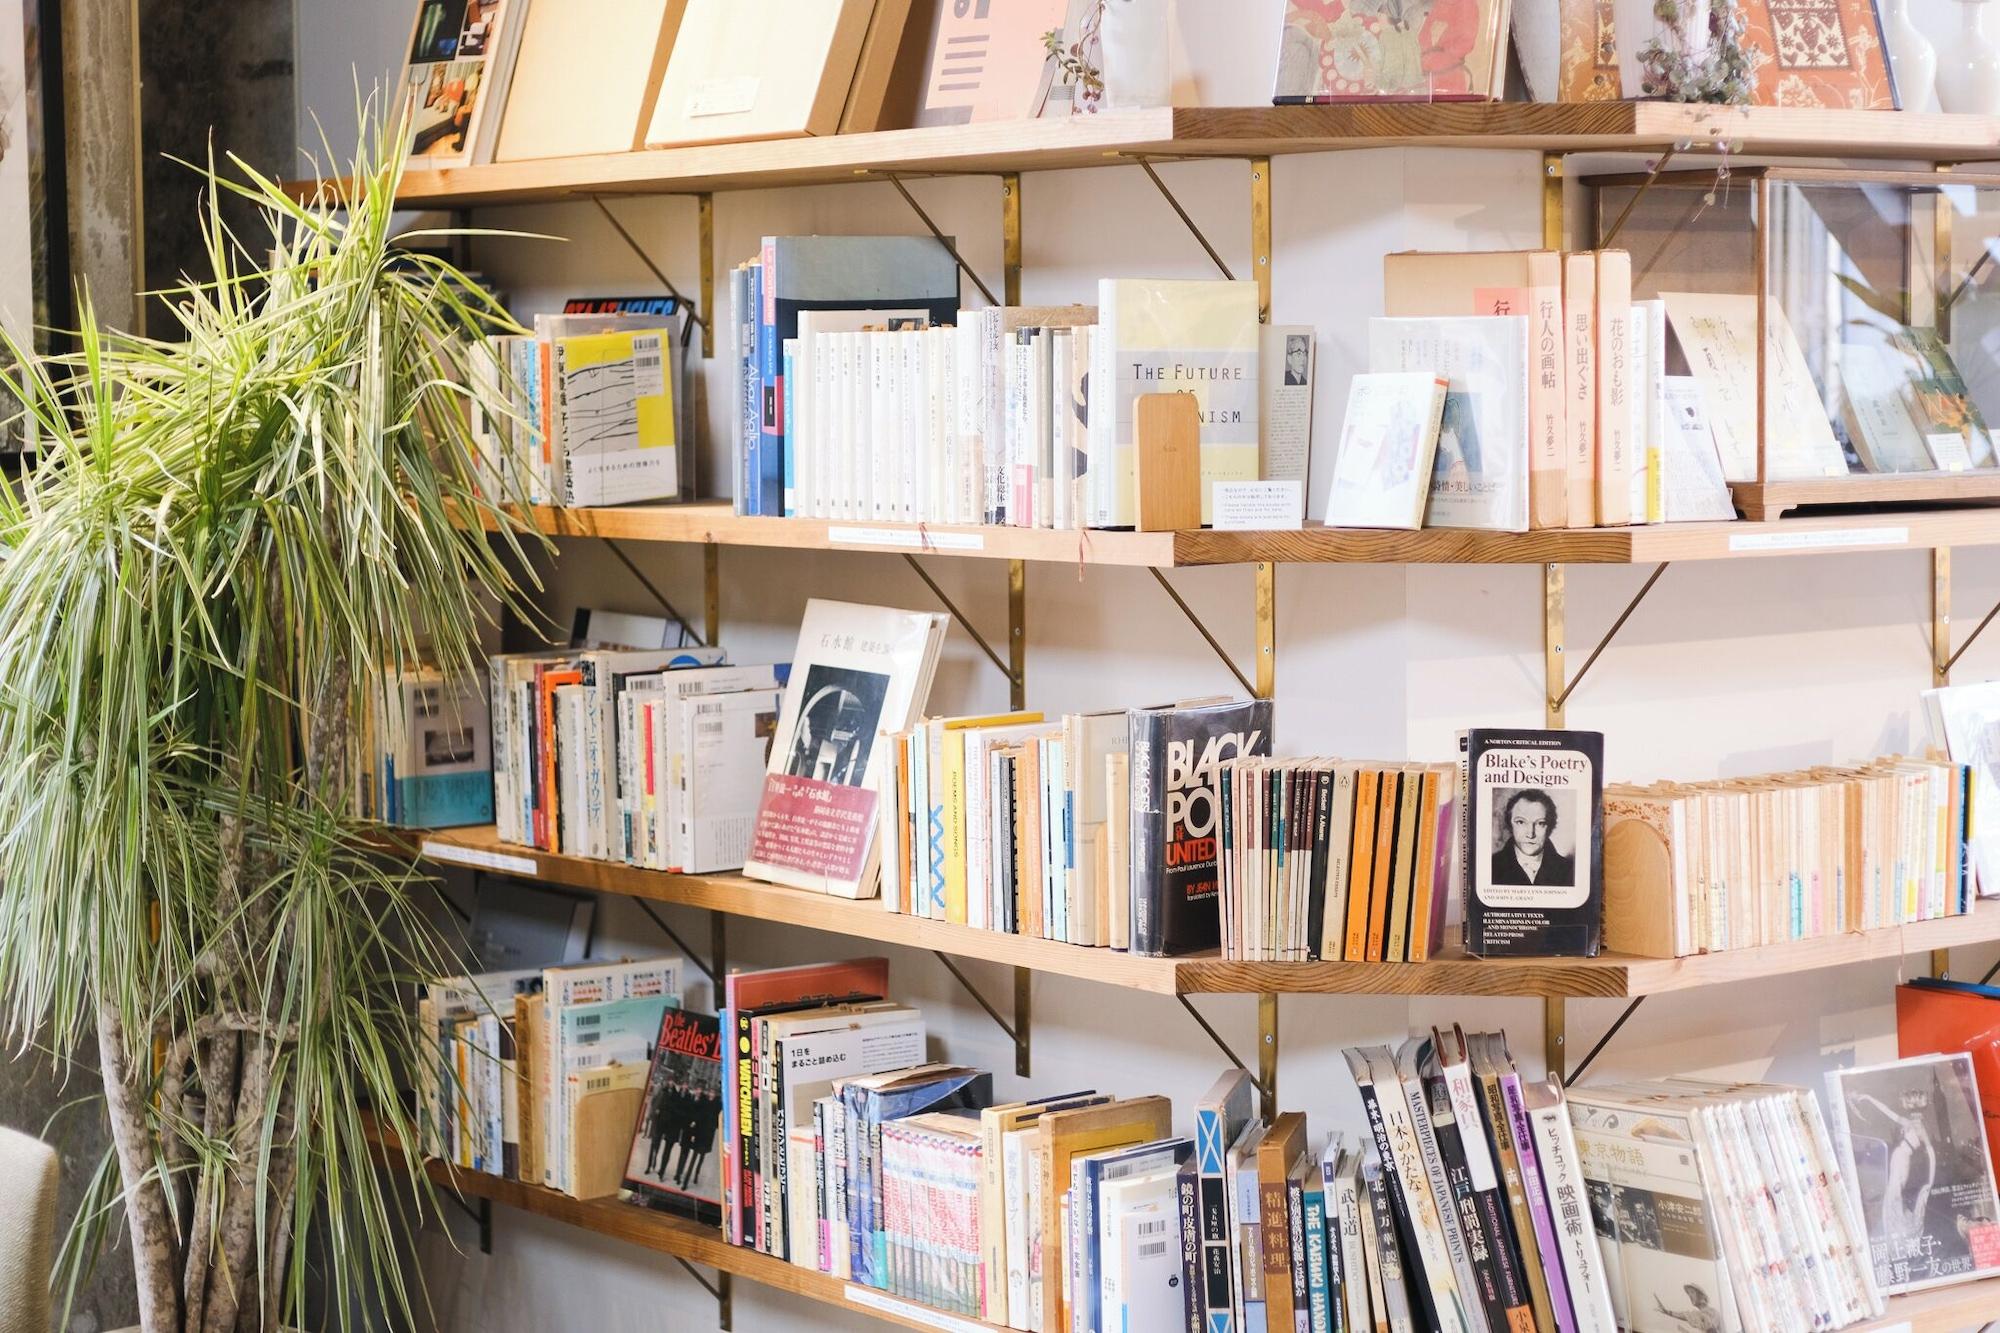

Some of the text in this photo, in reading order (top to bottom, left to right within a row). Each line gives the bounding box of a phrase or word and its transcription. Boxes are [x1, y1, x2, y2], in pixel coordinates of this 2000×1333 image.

[1540, 300, 1556, 389] 行人の画帖
[1575, 314, 1588, 401] 思い出ぐさ
[1610, 318, 1624, 406] 花のおも影
[748, 364, 760, 406] Alvar
[1133, 364, 1242, 380] THE FUTURE
[747, 410, 759, 450] Aalto
[585, 689, 600, 823] アントニオ・ガウディ
[1167, 730, 1261, 791] BLACK
[1484, 770, 1569, 786] and Designs
[1485, 753, 1588, 772] Blake's Poetry
[1166, 838, 1215, 865] UNITED
[659, 1012, 715, 1056] Beatles'
[791, 1048, 811, 1057] 1日を
[792, 1053, 847, 1069] まるごと詰め込む
[739, 1059, 752, 1137] WATCHMEN
[1388, 1110, 1421, 1193] 日本のかたな
[1578, 1139, 1645, 1167] 東京物語
[1409, 1091, 1464, 1264] MASTERPIECES OF JAPANESE PRINTS
[1180, 1182, 1197, 1263] 鏡の町皮膚の町
[1266, 1191, 1287, 1267] 精進料理
[1307, 1205, 1320, 1230] THE
[1341, 1188, 1358, 1236] 武士道
[1372, 1180, 1398, 1264] 北斎万華鏡
[1451, 1166, 1489, 1262] 江戸刑罰実録
[1485, 1194, 1502, 1237] TRADITIONAL
[1548, 1127, 1592, 1294] ヒッチコック 映画術 トリュフォー
[1658, 1199, 1702, 1216] 小津安二郎
[1309, 1234, 1323, 1287] KABUKI
[1876, 1257, 1973, 1287] 藤野一友の世界
